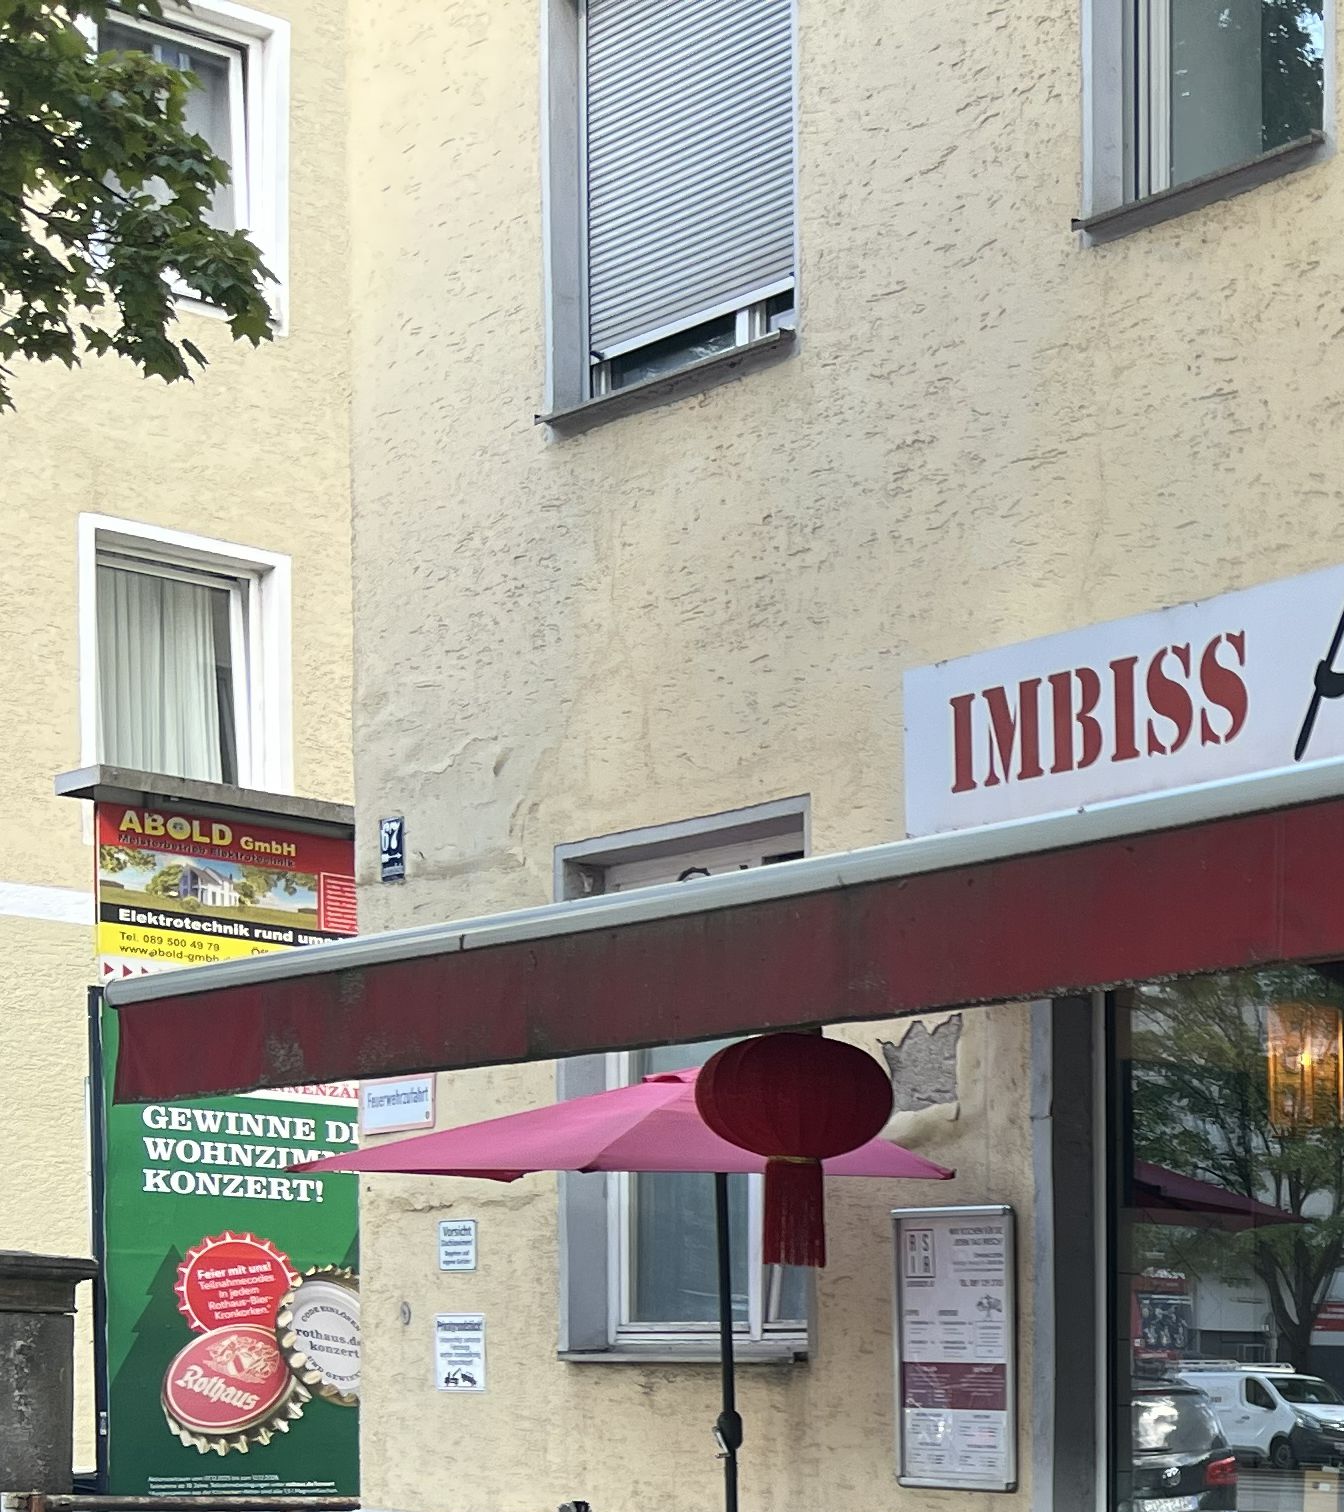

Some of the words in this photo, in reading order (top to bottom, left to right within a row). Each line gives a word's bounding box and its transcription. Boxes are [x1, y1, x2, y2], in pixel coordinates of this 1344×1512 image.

[950, 631, 1248, 794] IMBISS
[119, 809, 233, 847] ABOLD
[240, 836, 297, 857] GmbH
[381, 821, 401, 852] 67
[118, 908, 250, 938] Elektrotechnik
[254, 929, 293, 944] rund
[119, 931, 139, 943] Tel.
[143, 933, 163, 945] 089
[167, 936, 187, 949] 500
[190, 939, 204, 950] 49
[142, 1104, 316, 1142] GEWINNE
[142, 1168, 324, 1203] KONZERT!
[197, 1267, 225, 1280] Feier
[228, 1264, 246, 1277] mit
[249, 1262, 272, 1274] uns!
[218, 1290, 229, 1299] in
[230, 1287, 260, 1300] jedem
[301, 1306, 320, 1323] CODE
[175, 1364, 260, 1411] Rothaus
